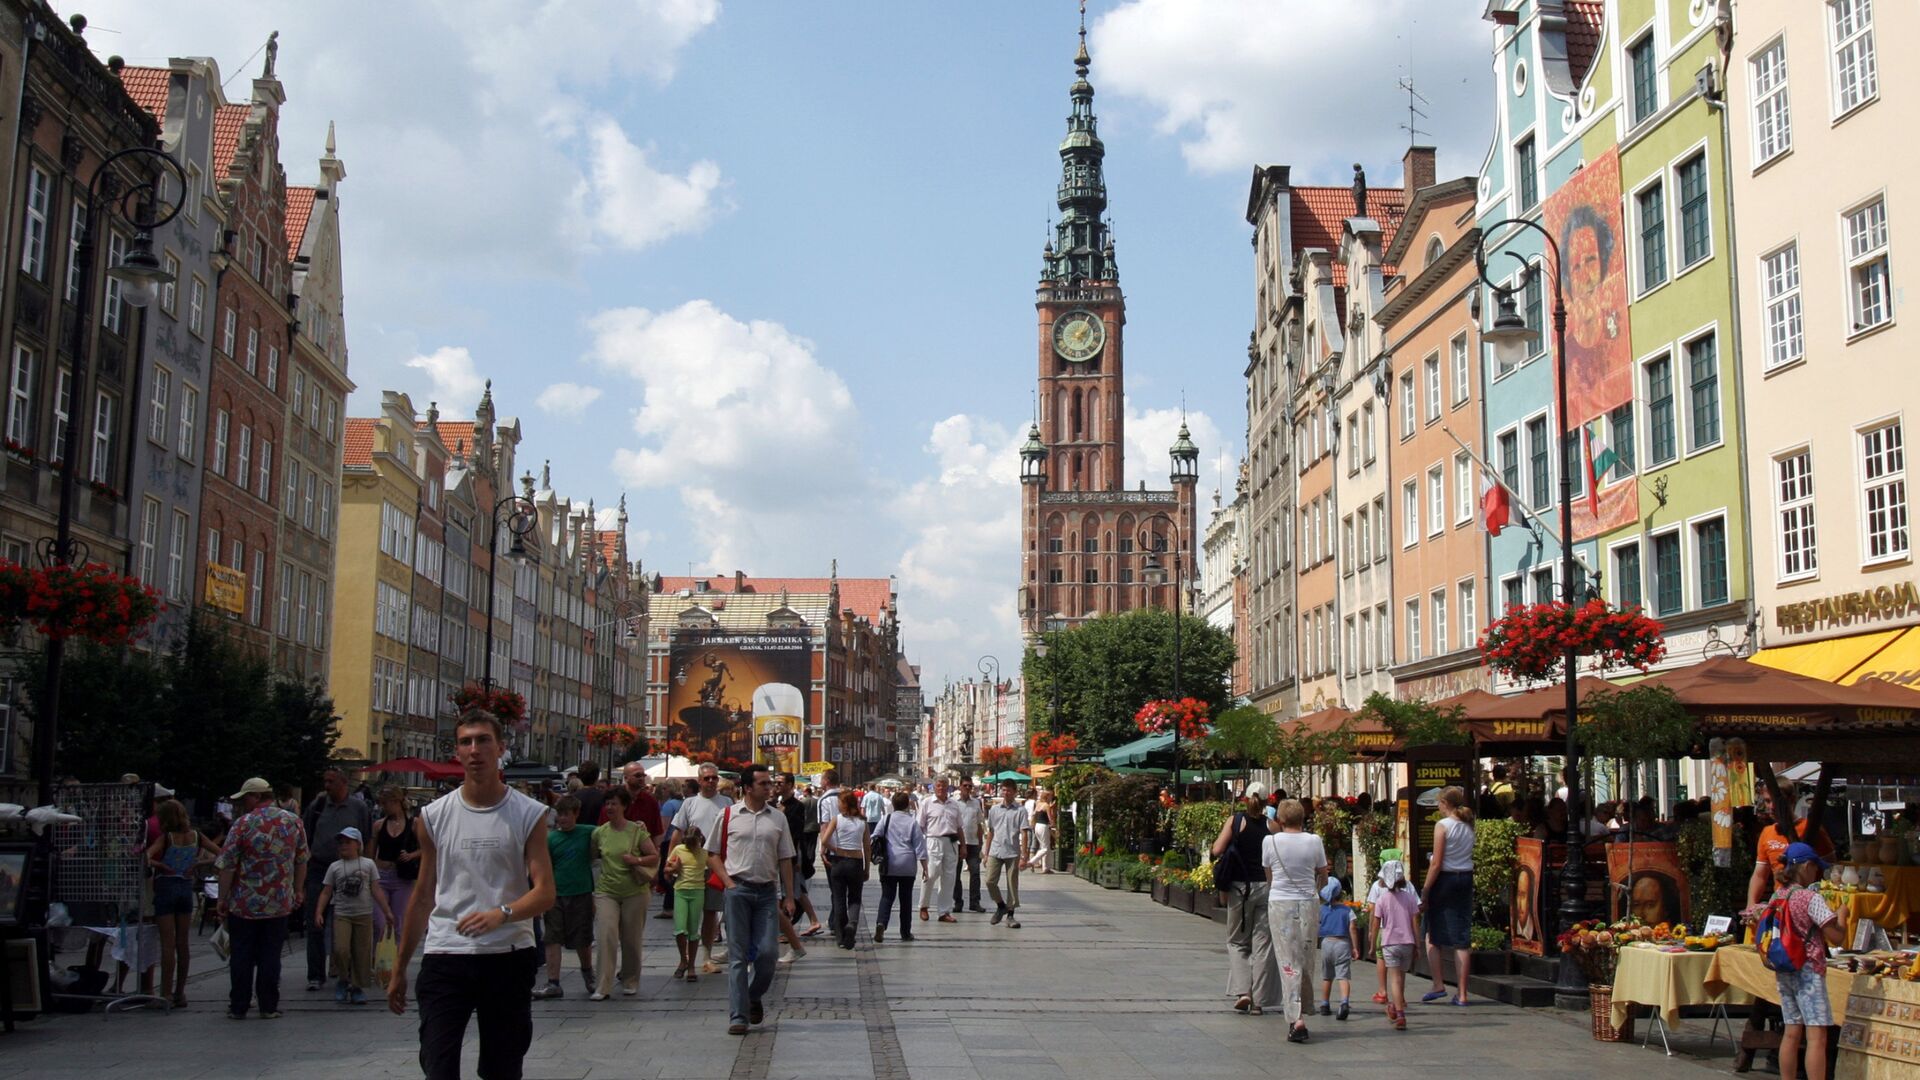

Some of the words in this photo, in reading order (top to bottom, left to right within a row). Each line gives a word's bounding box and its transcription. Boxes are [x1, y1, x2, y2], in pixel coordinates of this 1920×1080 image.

[702, 636, 741, 645] JARMARK
[1705, 715, 1726, 724] BAR
[1731, 715, 1807, 726] RESTAURACJA
[1856, 708, 1912, 722] SPHINX
[1493, 719, 1545, 735] SPHI
[1416, 767, 1461, 778] SPHINX
